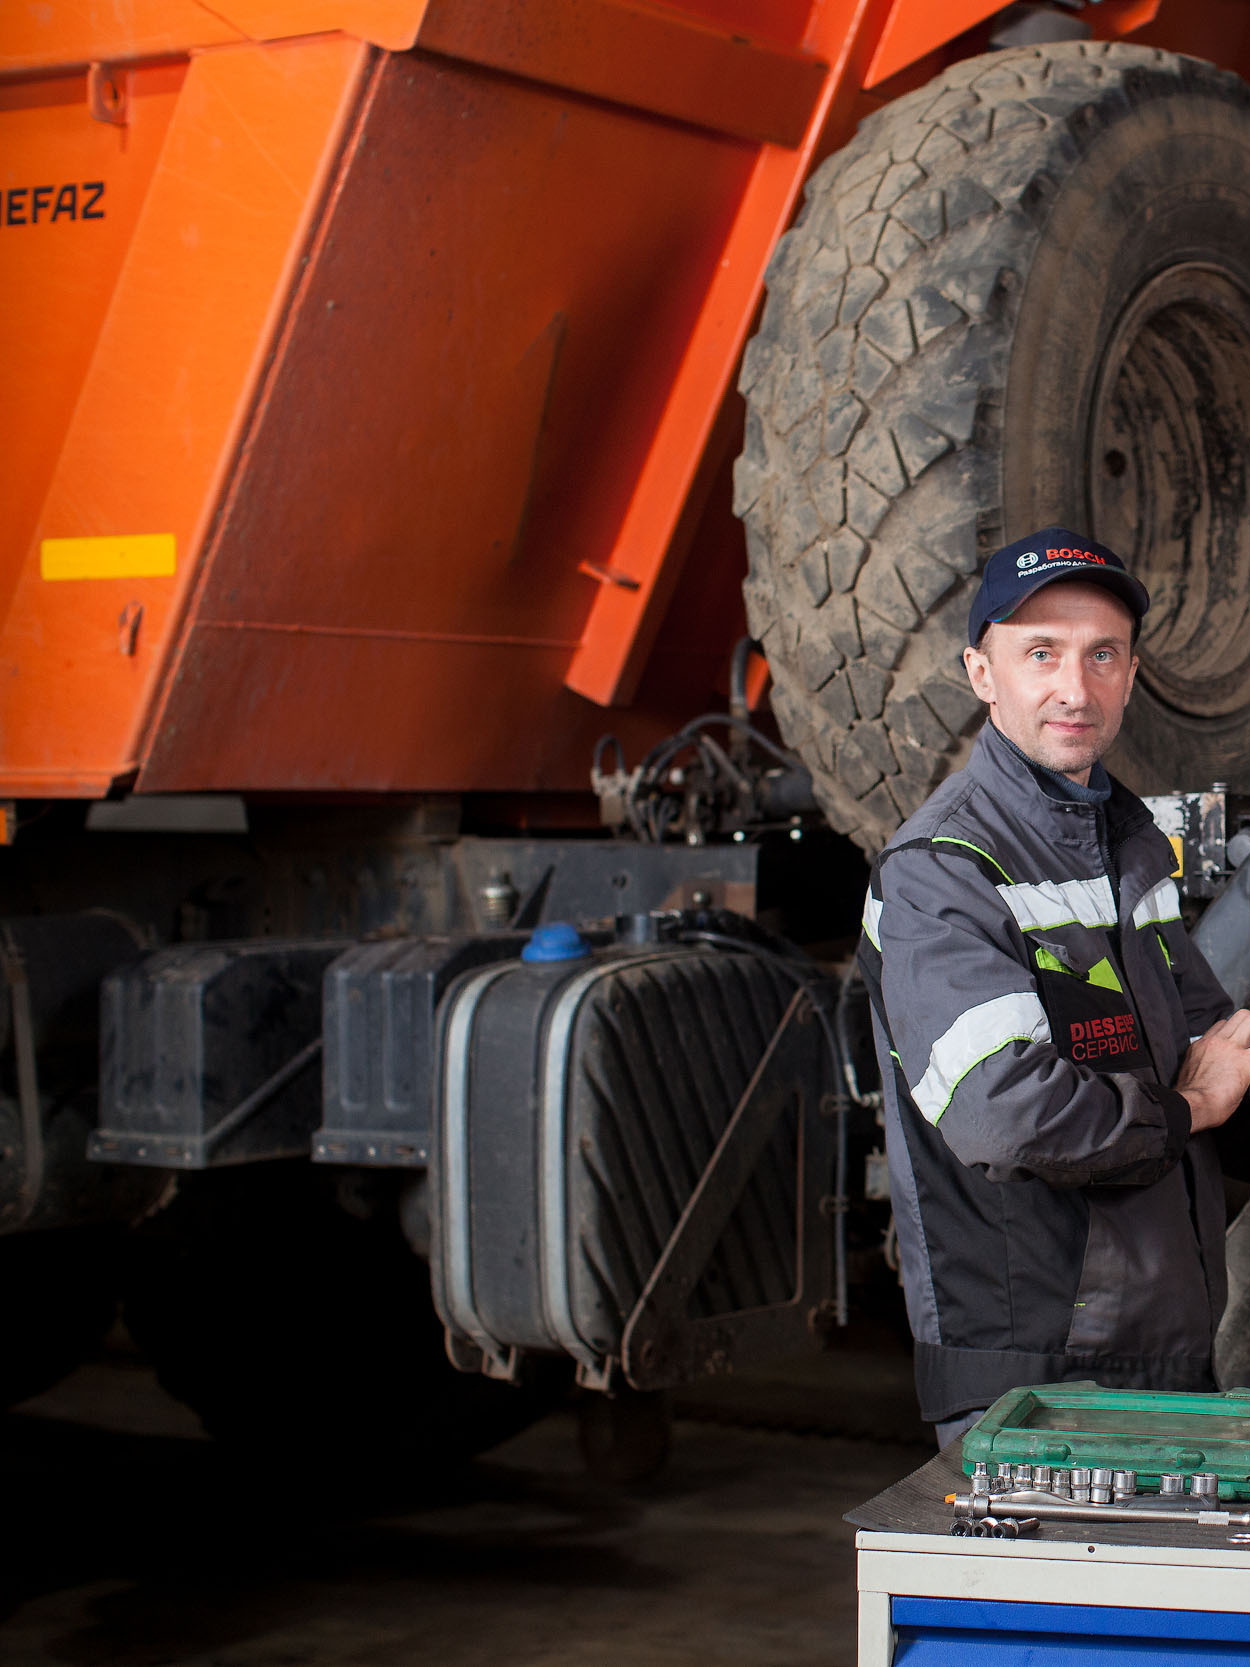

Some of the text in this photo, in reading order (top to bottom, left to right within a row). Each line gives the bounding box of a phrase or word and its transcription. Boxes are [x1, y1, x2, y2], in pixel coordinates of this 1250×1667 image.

[0, 182, 105, 226] EFAZ
[1046, 548, 1105, 565] BOSCH
[1072, 1033, 1139, 1060] СЕРВИС
